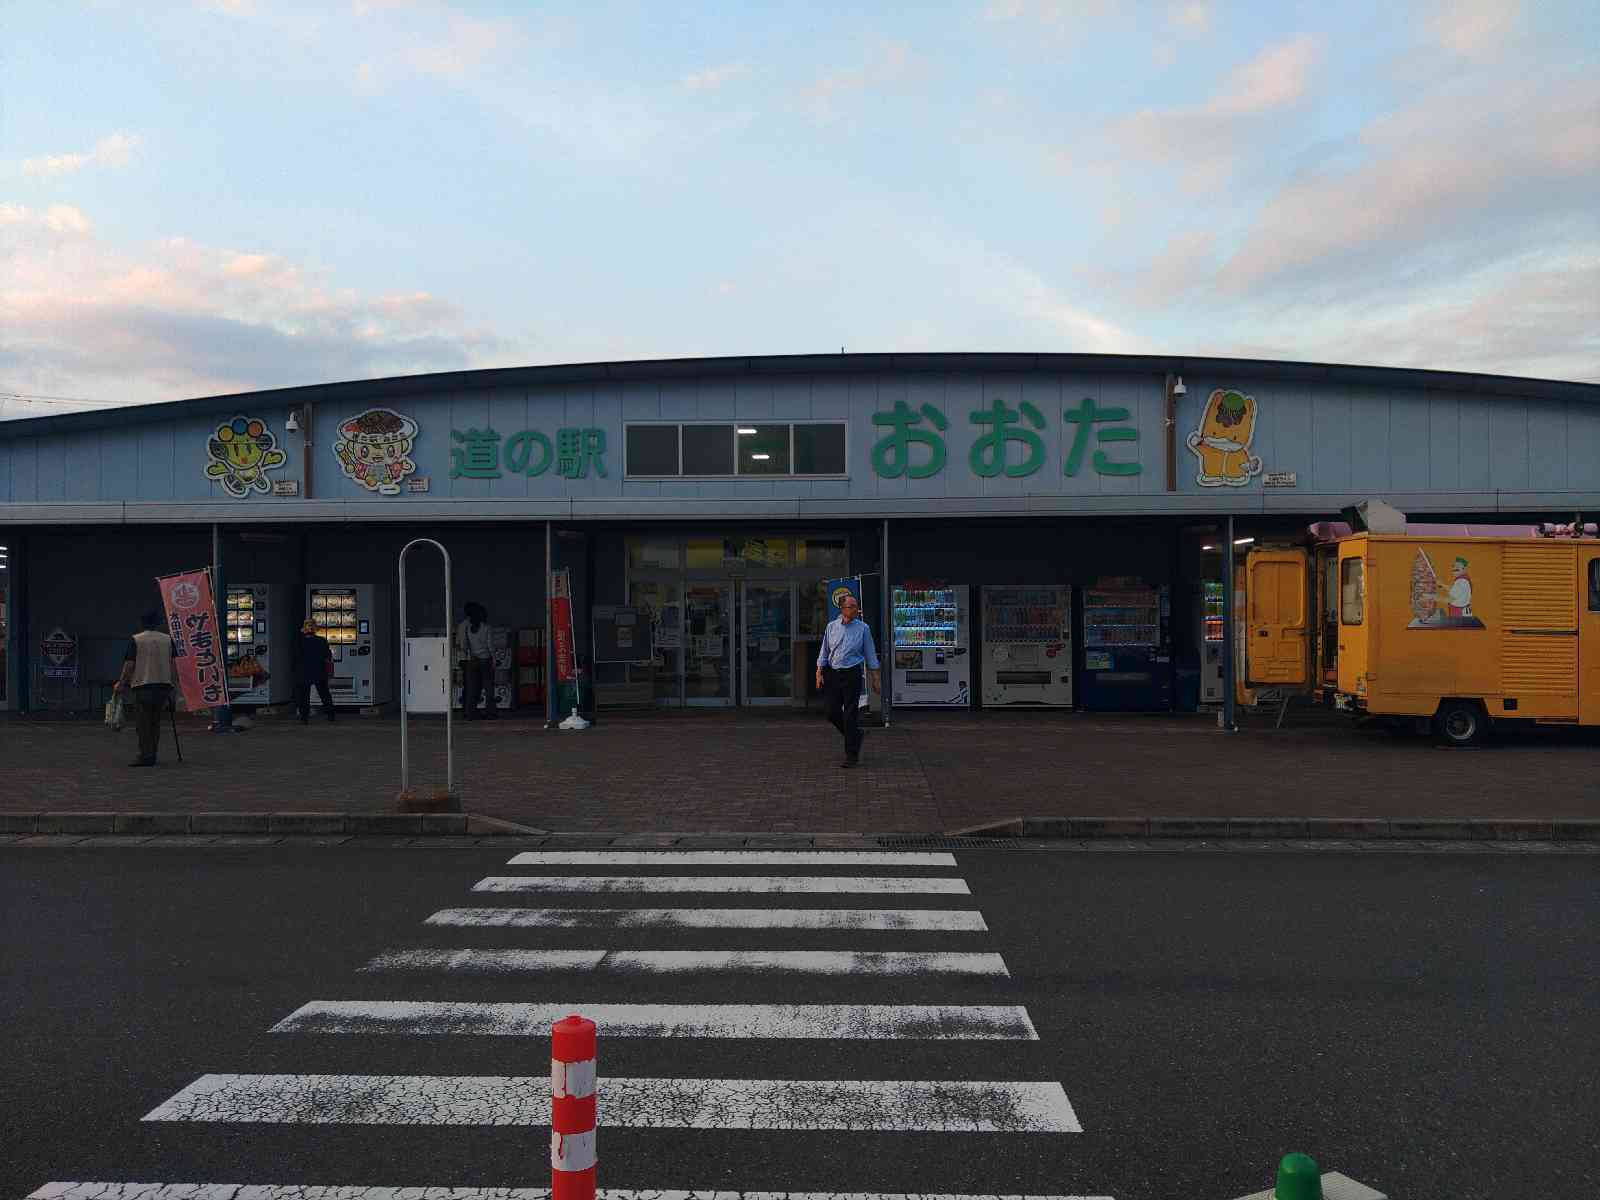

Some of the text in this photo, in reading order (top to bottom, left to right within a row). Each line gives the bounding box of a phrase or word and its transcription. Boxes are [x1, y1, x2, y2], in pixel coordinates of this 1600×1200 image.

[450, 399, 1142, 478] 道の駅 おおた
